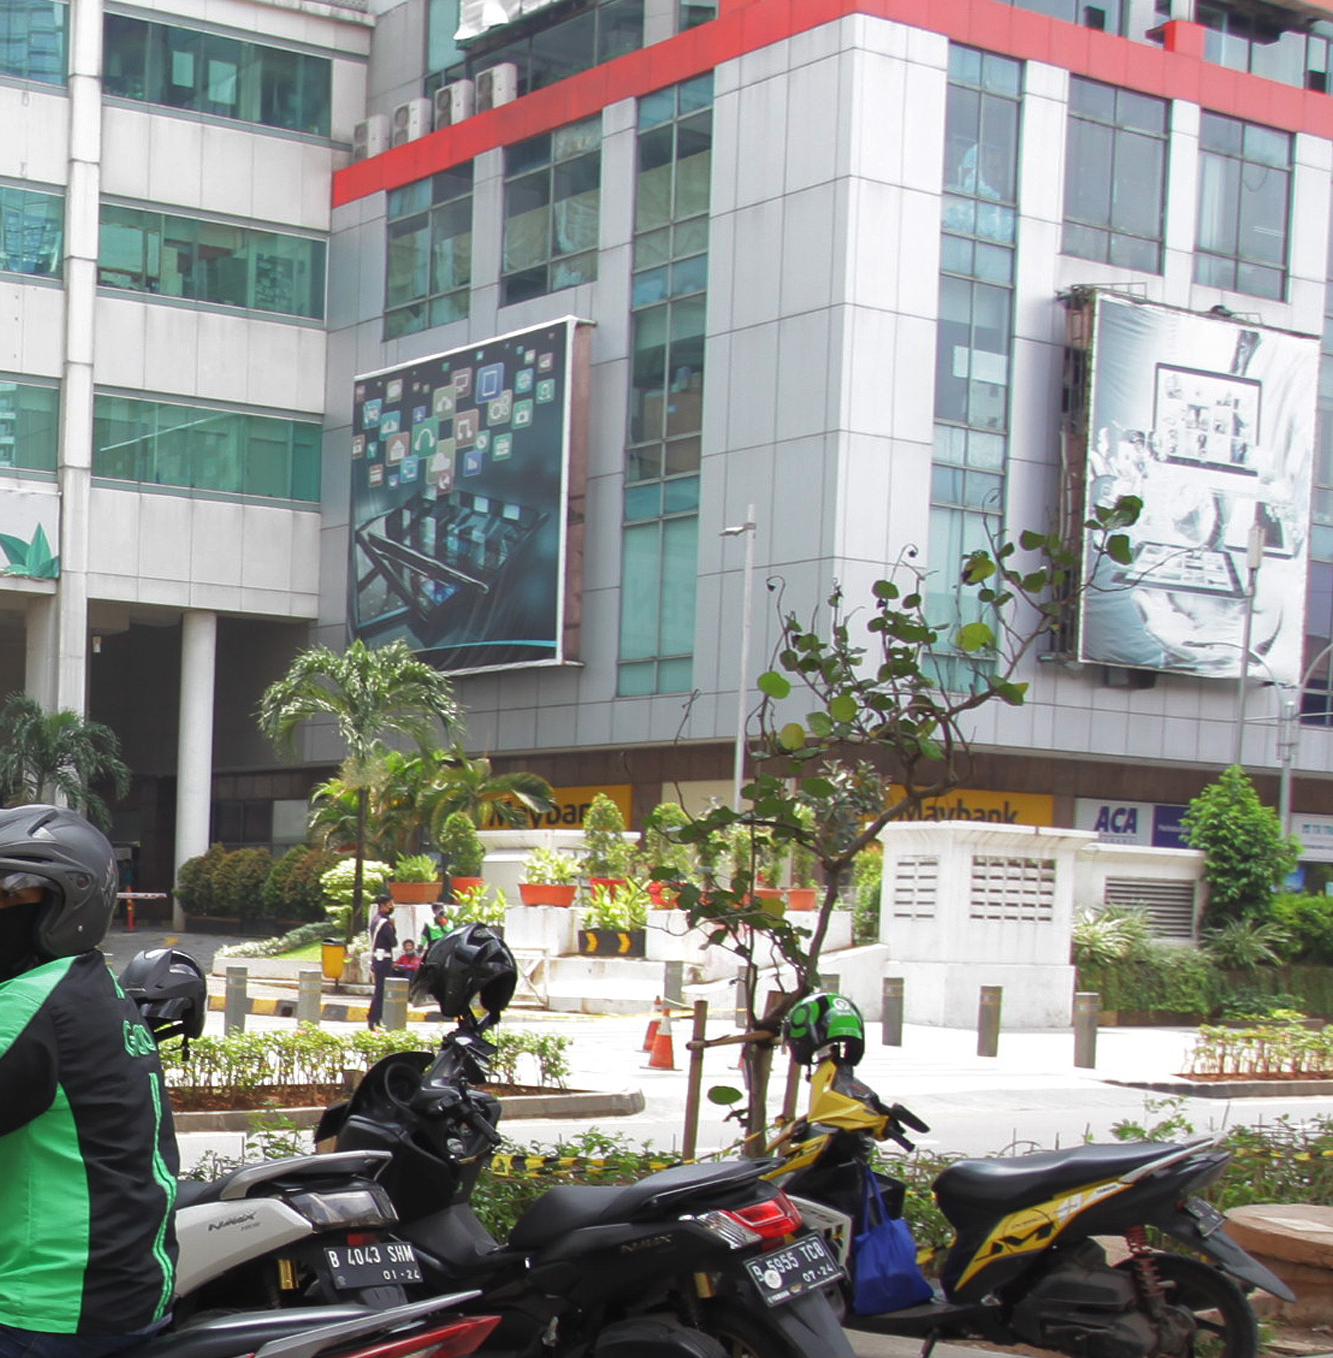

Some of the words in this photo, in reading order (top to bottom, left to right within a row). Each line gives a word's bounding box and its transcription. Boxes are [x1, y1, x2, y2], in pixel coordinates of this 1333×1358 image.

[1094, 806, 1138, 834] ACA
[328, 1250, 340, 1268] B
[347, 1246, 381, 1266] 4043
[386, 1244, 415, 1263] SHM
[766, 1252, 800, 1273] 5955
